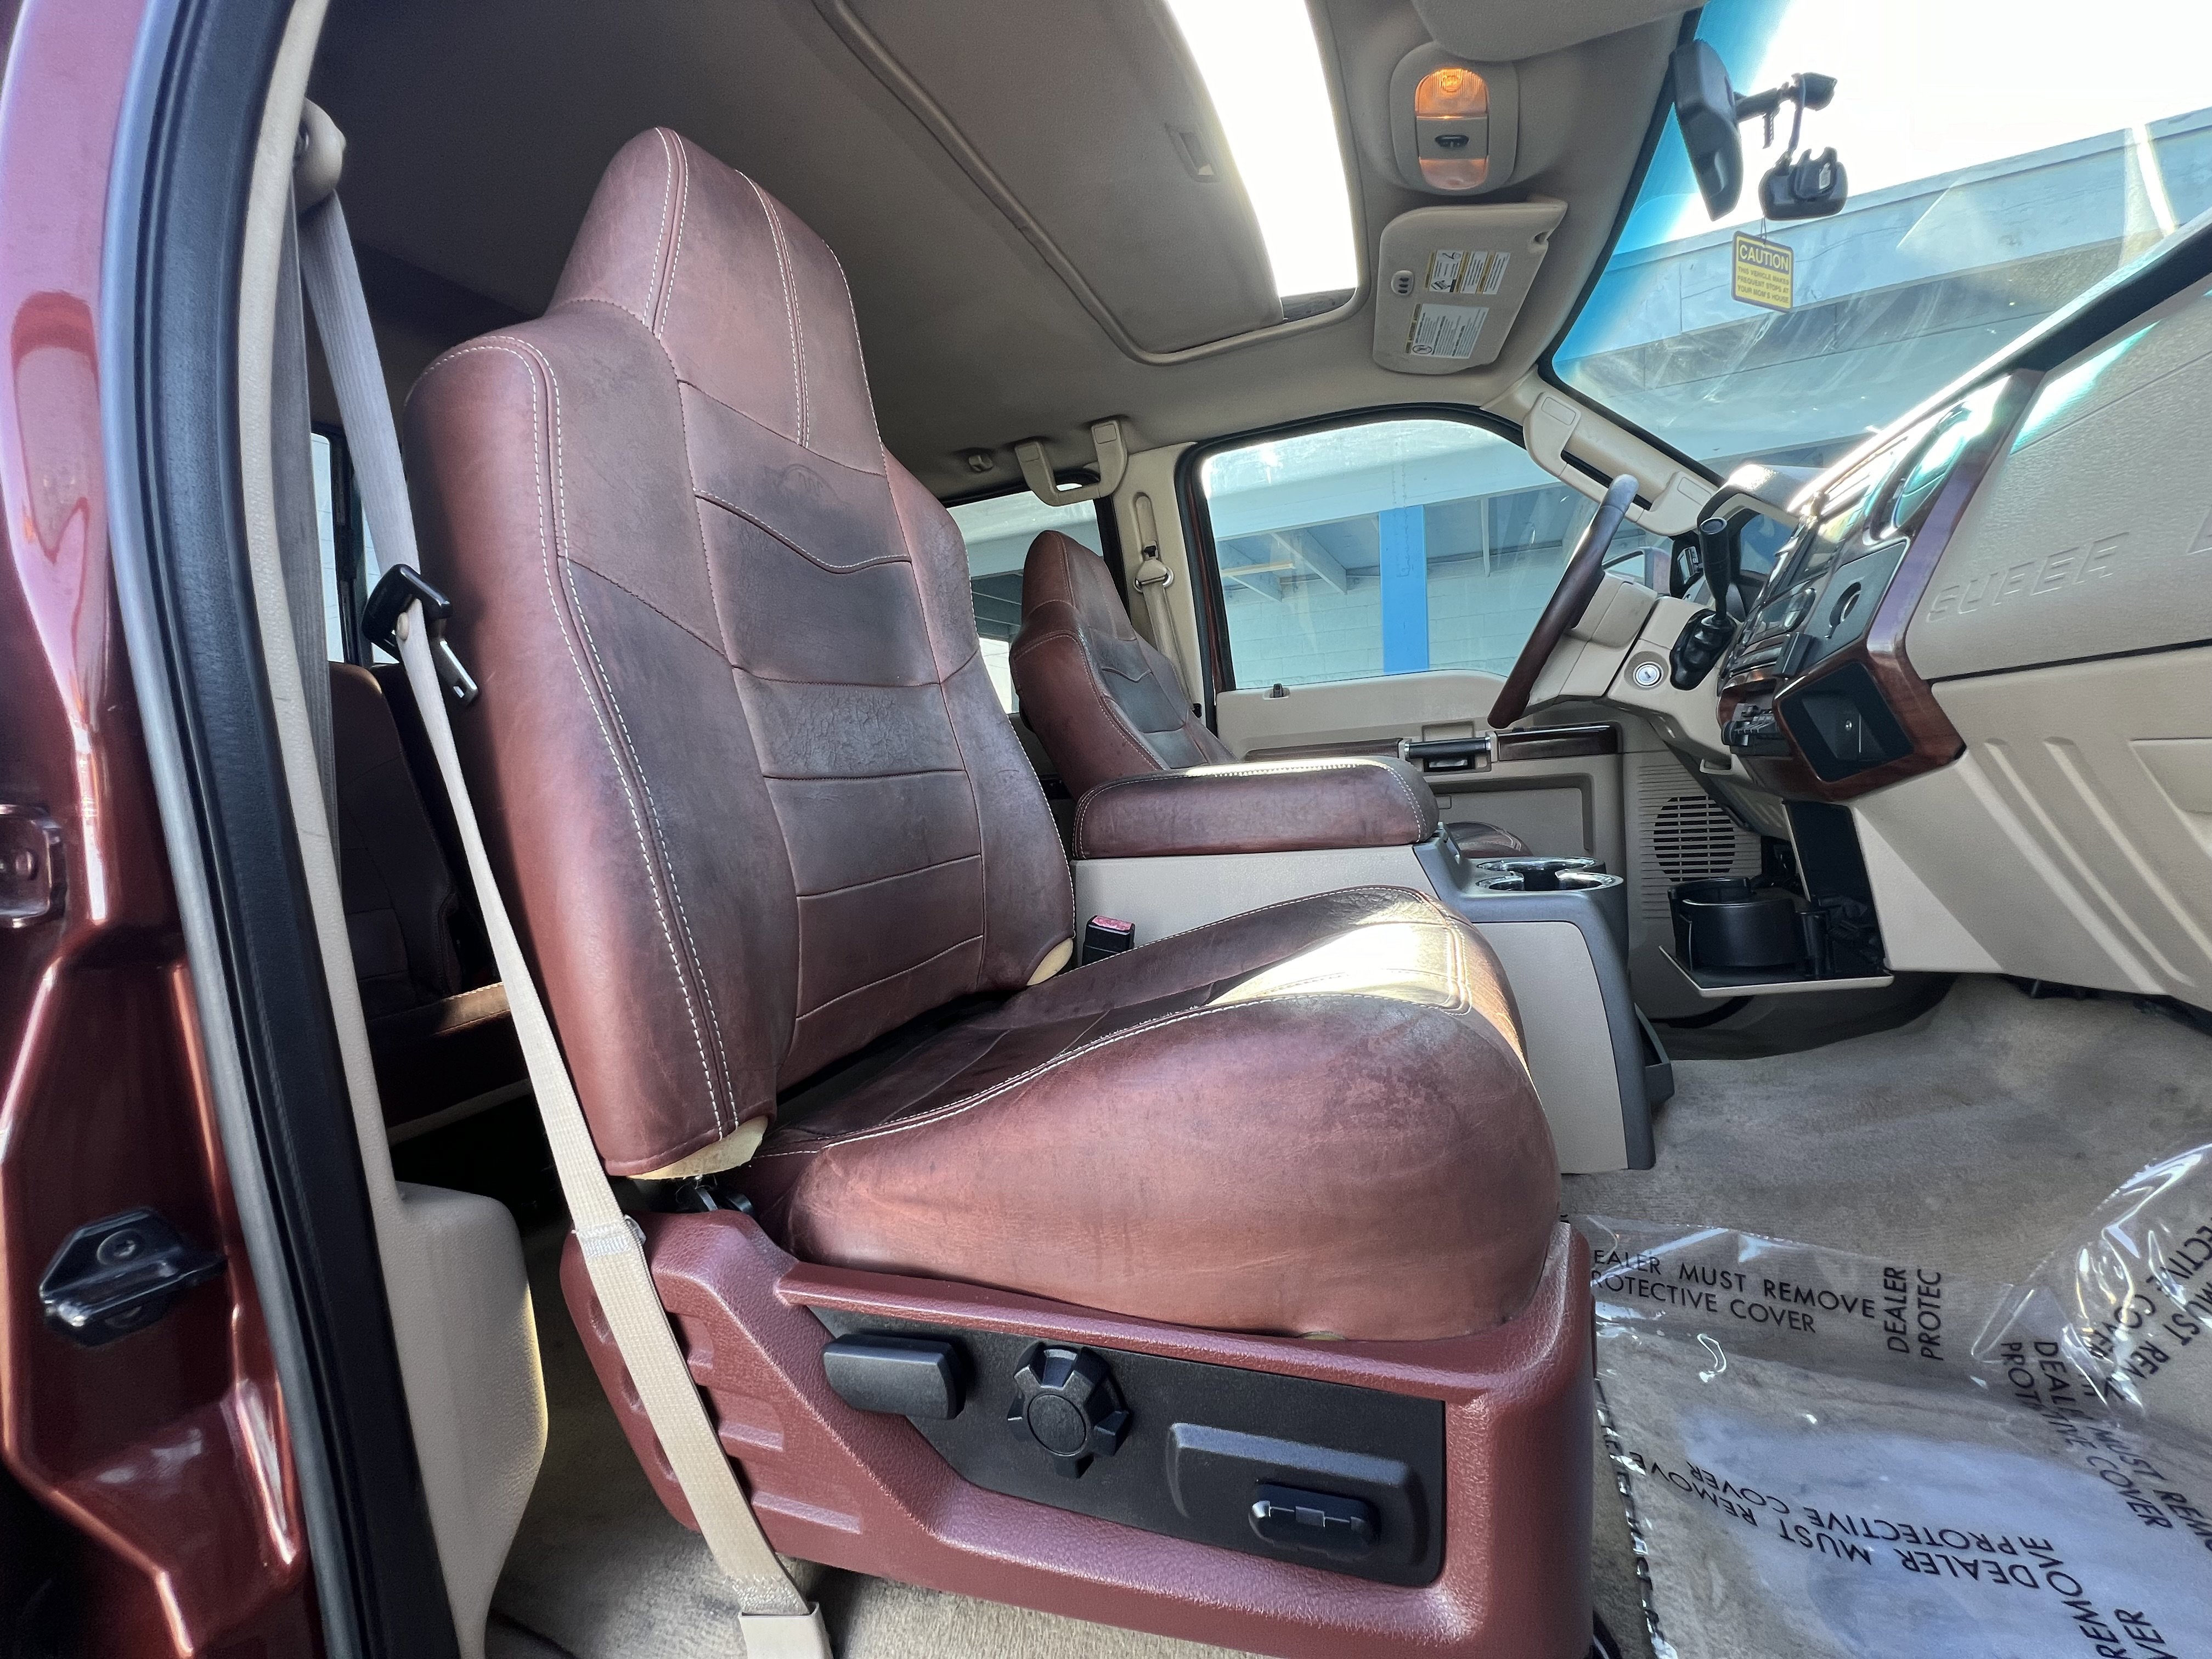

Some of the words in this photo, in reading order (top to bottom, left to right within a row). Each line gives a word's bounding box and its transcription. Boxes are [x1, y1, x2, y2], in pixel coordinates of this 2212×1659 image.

[1738, 266, 1749, 274] THIS
[1751, 269, 1771, 280] VEHICLE
[1773, 275, 1789, 285] MAKES
[1740, 244, 1788, 271] CAUTION
[1737, 275, 1765, 287] FREQUENT
[1766, 283, 1782, 292] STOPS
[1737, 285, 1752, 293] YOUR
[1772, 294, 1789, 303] HOUSE
[1926, 532, 2130, 623] SUPER
[1679, 1263, 1746, 1293] MUST
[1763, 1279, 1876, 1319] REMOVE
[1730, 1299, 1816, 1333] COVER
[1883, 1265, 1910, 1354] DEALER
[1917, 1268, 1944, 1362] PROTEC
[1628, 1451, 1758, 1527] REMOVE
[1686, 1460, 1790, 1514] COVER
[2086, 1456, 2173, 1528] COVER
[1779, 1519, 1872, 1566] MUST
[1803, 1506, 2018, 1555] PROTECTIVE
[2153, 1489, 2212, 1551] REM
[1893, 1548, 2040, 1589] DEALER
